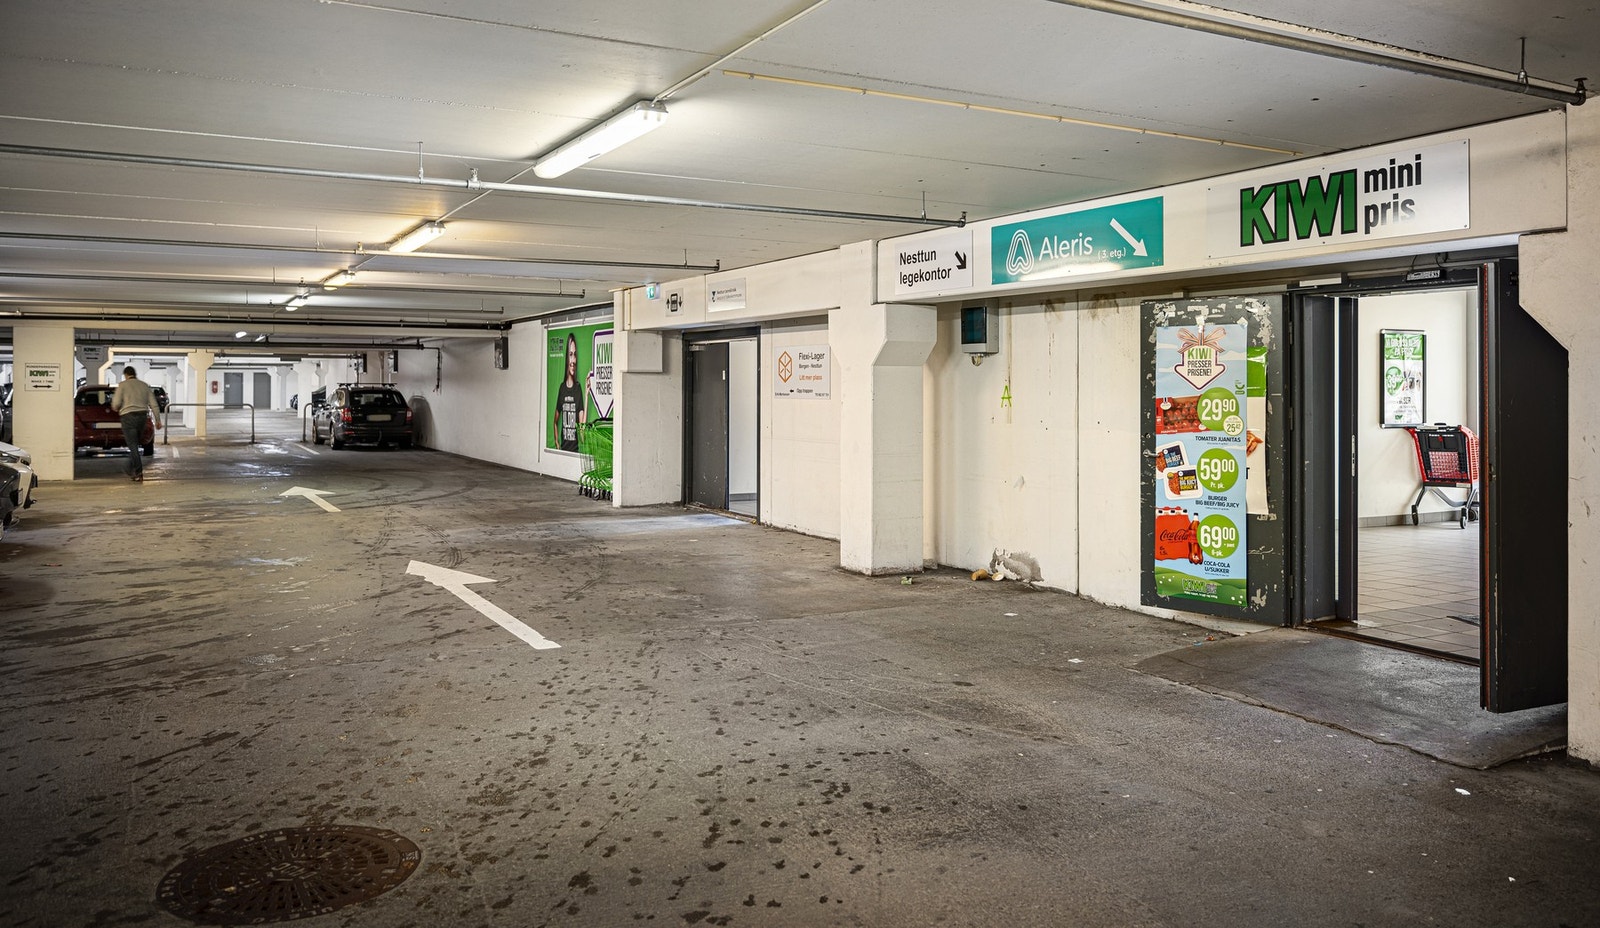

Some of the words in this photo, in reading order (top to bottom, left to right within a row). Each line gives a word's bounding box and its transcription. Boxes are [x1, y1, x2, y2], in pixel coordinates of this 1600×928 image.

[1364, 153, 1422, 194] mini
[1240, 168, 1358, 248] KIWI
[1364, 193, 1416, 235] pris
[1038, 232, 1094, 262] Aleris
[899, 250, 937, 266] Nesttun
[899, 266, 952, 287] legekontor
[596, 342, 613, 364] KIWI
[798, 352, 825, 361] Flexi-Lager
[1188, 348, 1212, 359] KIWI
[1187, 360, 1212, 368] PRESSER
[1187, 368, 1212, 377] PRISENE!
[1204, 560, 1230, 568] COCA-COLA
